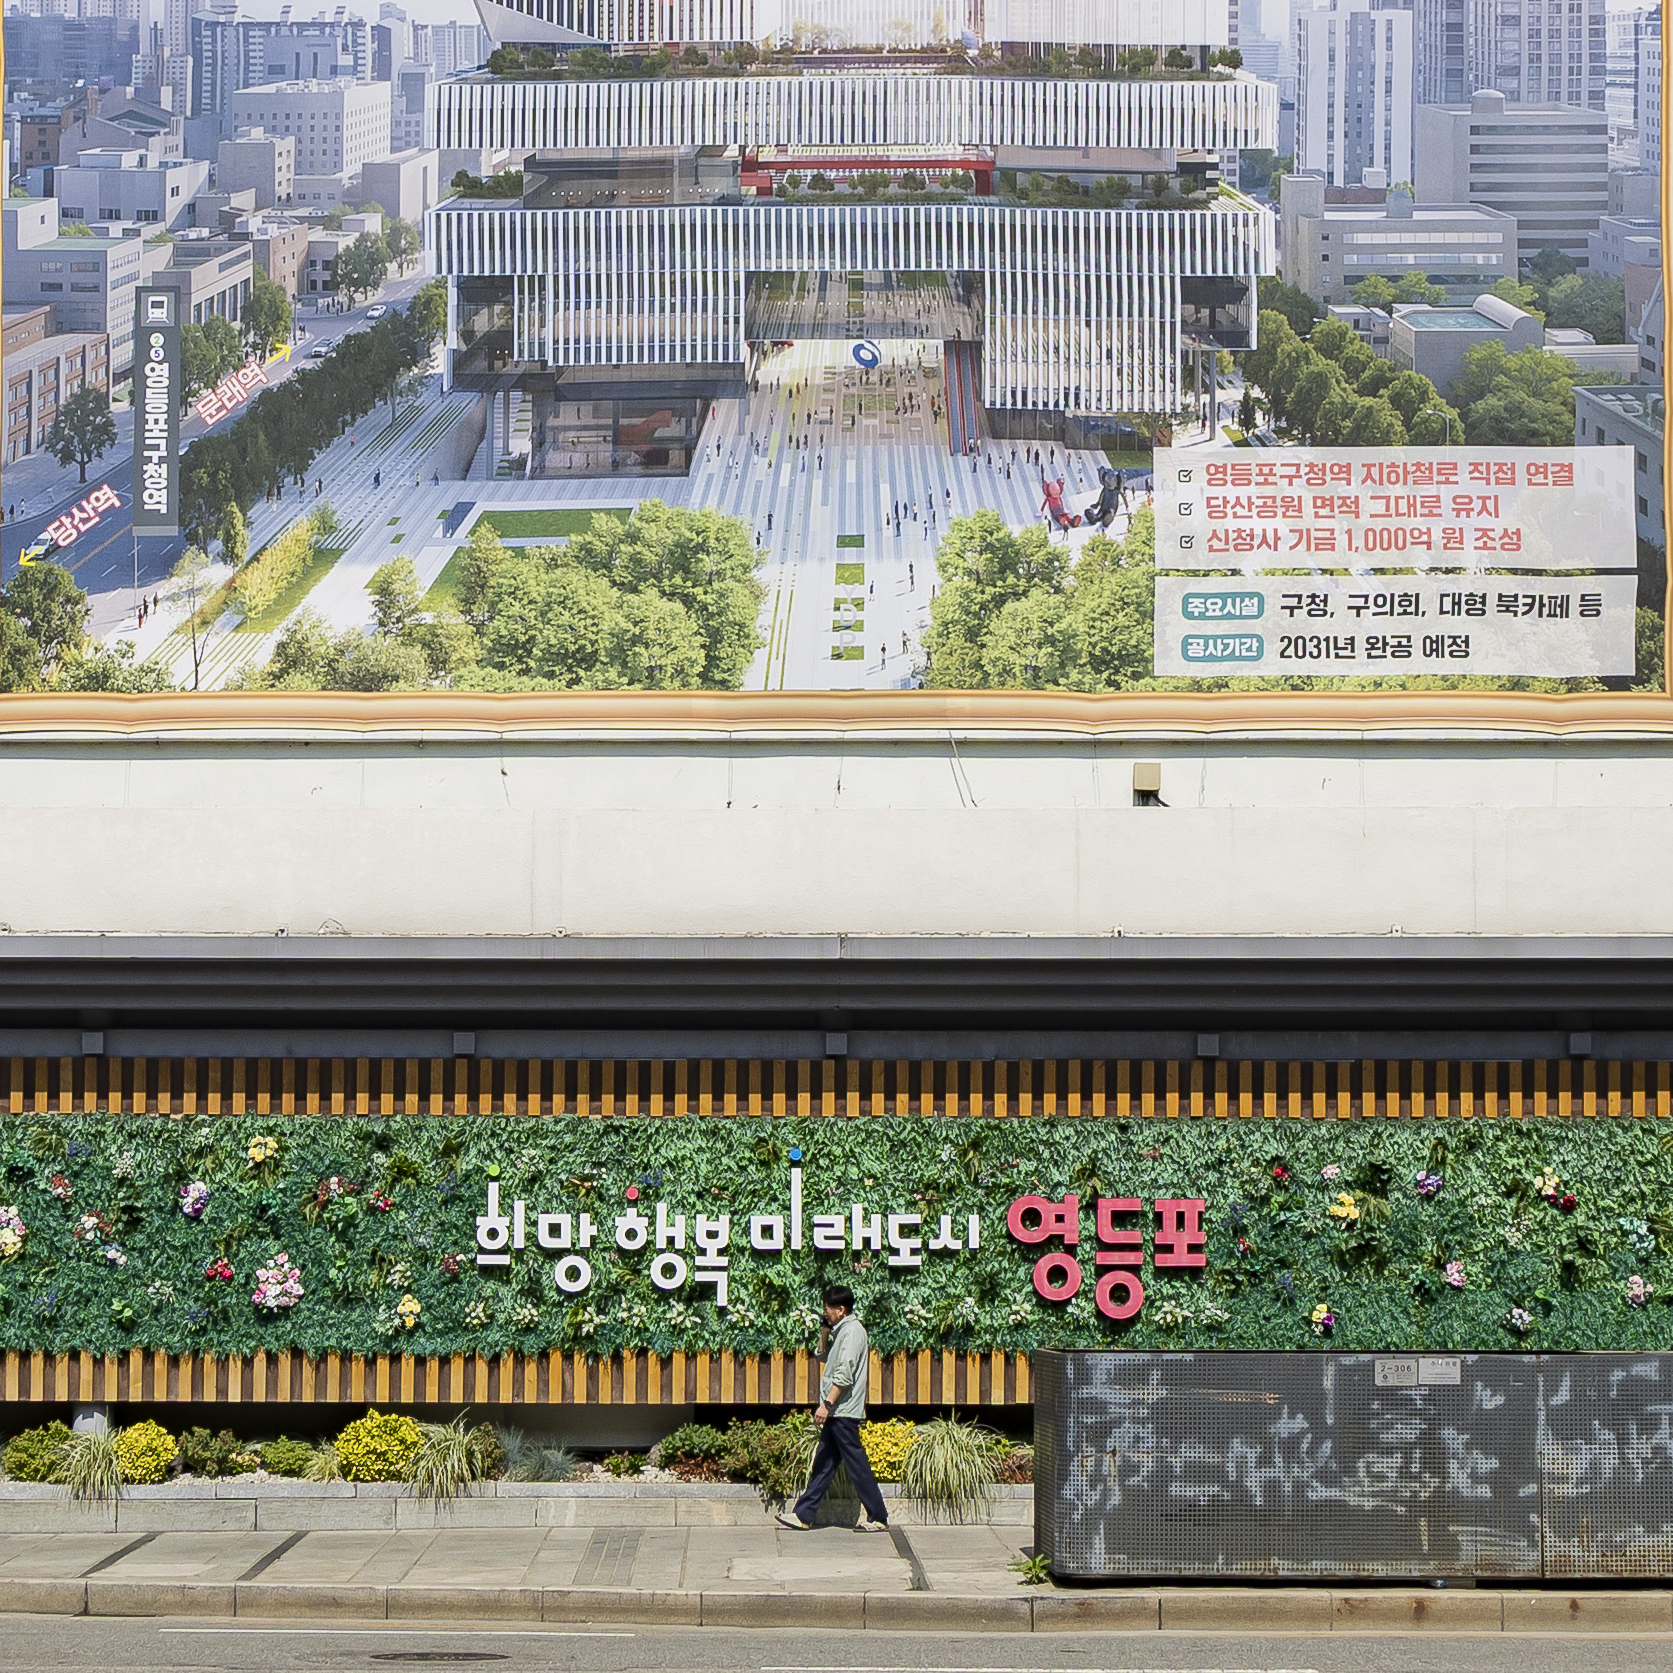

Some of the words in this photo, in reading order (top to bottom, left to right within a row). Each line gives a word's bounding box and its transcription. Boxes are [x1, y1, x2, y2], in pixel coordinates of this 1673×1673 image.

[194, 361, 270, 427] 문래역
[143, 361, 171, 515] 영등포구청역
[1205, 462, 1352, 488] 영등포구청역
[1361, 462, 1459, 487] 지하철로
[1469, 462, 1517, 488] 직접
[1525, 462, 1574, 488] 연결
[46, 483, 122, 549] 당산역
[1206, 495, 1304, 520] 당산공원
[1312, 495, 1360, 521] 면적
[1369, 495, 1443, 519] 그대로
[1451, 495, 1500, 520] 유지
[1206, 527, 1281, 553] 신청사
[1288, 527, 1337, 552] 기금
[1346, 527, 1433, 554] 1,000억
[1441, 527, 1466, 553] 원
[1473, 527, 1523, 553] 조성
[1186, 596, 1260, 617] 주요시설
[1280, 593, 1336, 620] 구청,
[1346, 593, 1428, 620] 구의회,
[1438, 593, 1488, 619] 대형
[1495, 593, 1571, 620] 북카페
[1578, 593, 1604, 619] 등
[1186, 637, 1260, 659] 공사기간
[1279, 635, 1357, 661] 2031년
[1364, 635, 1414, 660] 완공
[1422, 635, 1471, 660] 예정
[476, 1164, 598, 1293] 희망
[615, 1187, 729, 1306] 행복
[749, 1147, 981, 1267] 미래도시
[1006, 1193, 1207, 1319] 영등포
